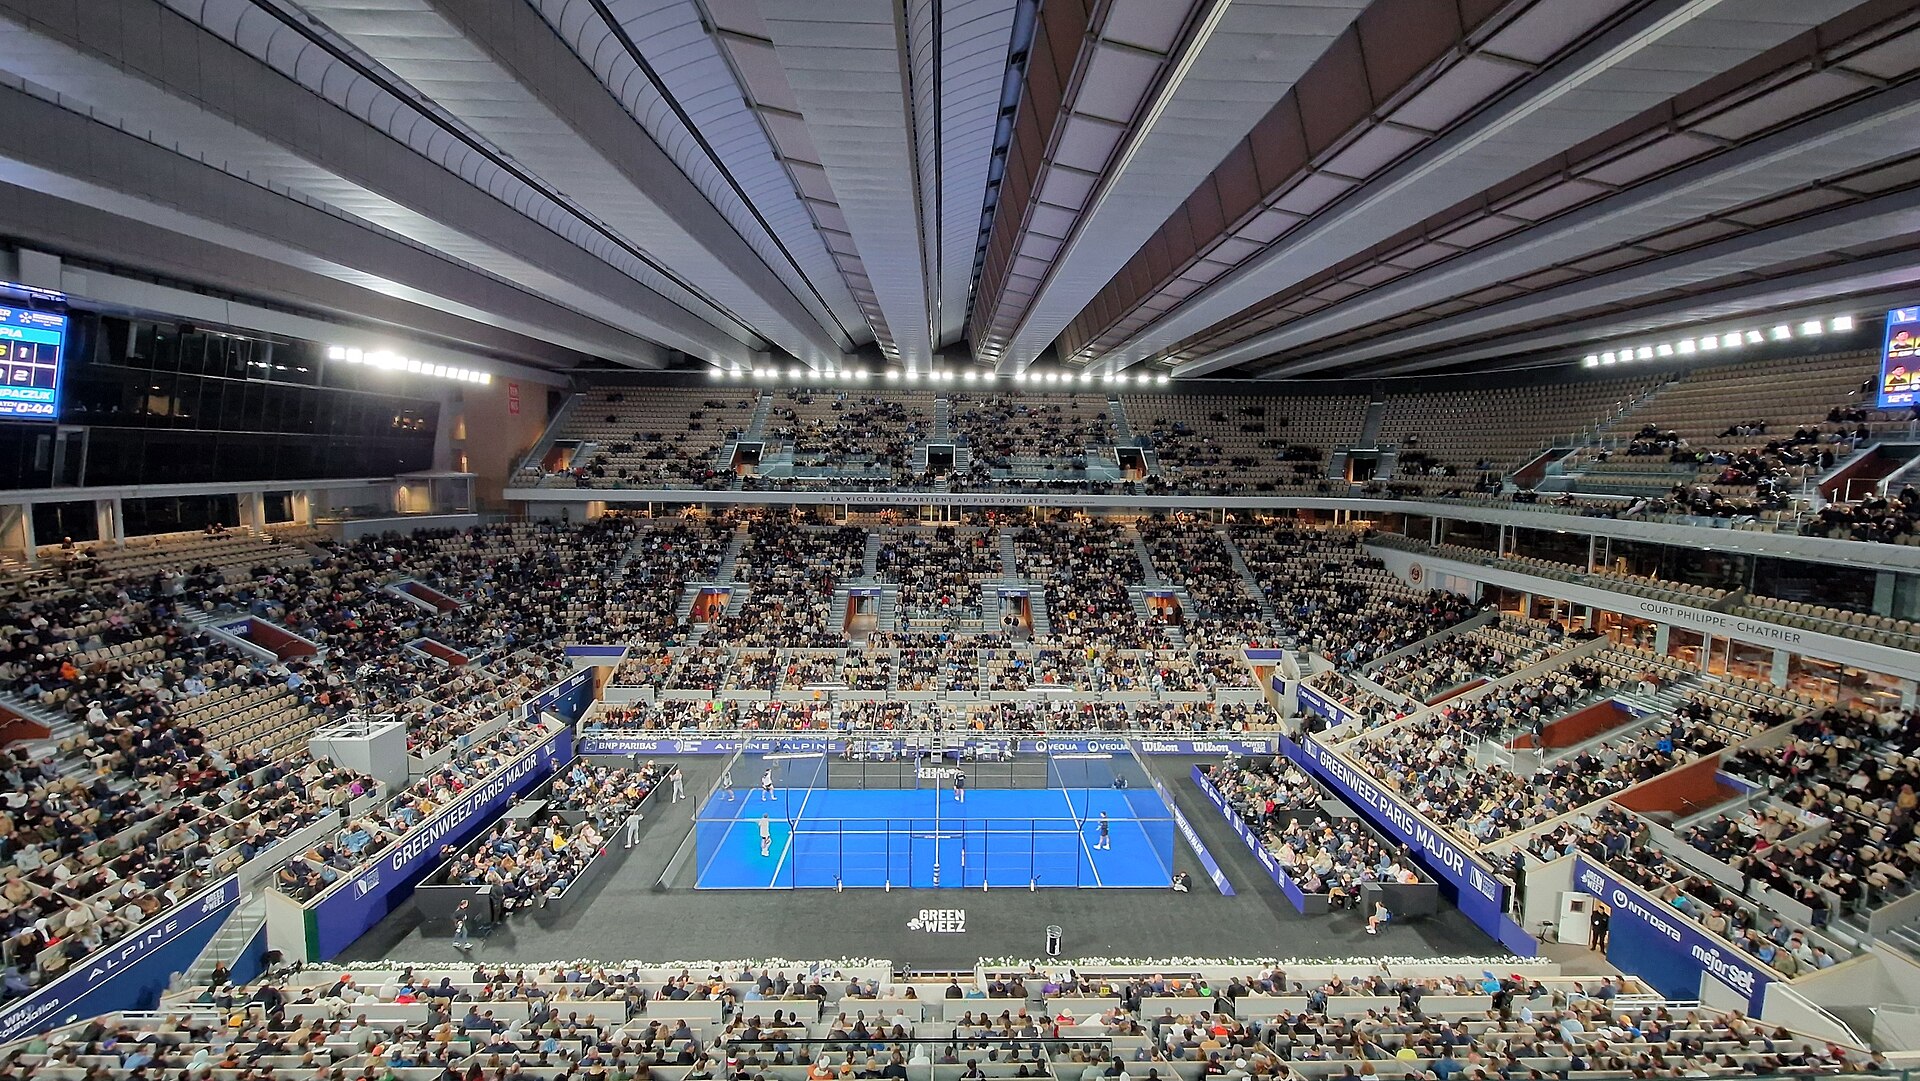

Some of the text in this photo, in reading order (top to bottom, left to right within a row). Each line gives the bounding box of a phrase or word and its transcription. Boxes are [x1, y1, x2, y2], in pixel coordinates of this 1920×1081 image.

[13, 369, 29, 381] 2
[16, 402, 54, 414] 0:44
[1640, 602, 1674, 616] COURT
[1677, 609, 1727, 628] PHILIPPE
[1737, 622, 1801, 643] CHATRIER
[598, 742, 658, 750] BNP PARIBAS
[1142, 741, 1229, 752] Wilson Wilson
[392, 753, 538, 871] GREENWEEZ PARIS MAJOR
[1319, 751, 1464, 877] GREENWEEZ PARIS MAJOR
[919, 909, 966, 921] GREEN
[924, 920, 966, 933] WEEZ
[88, 919, 178, 982] ALPINE
